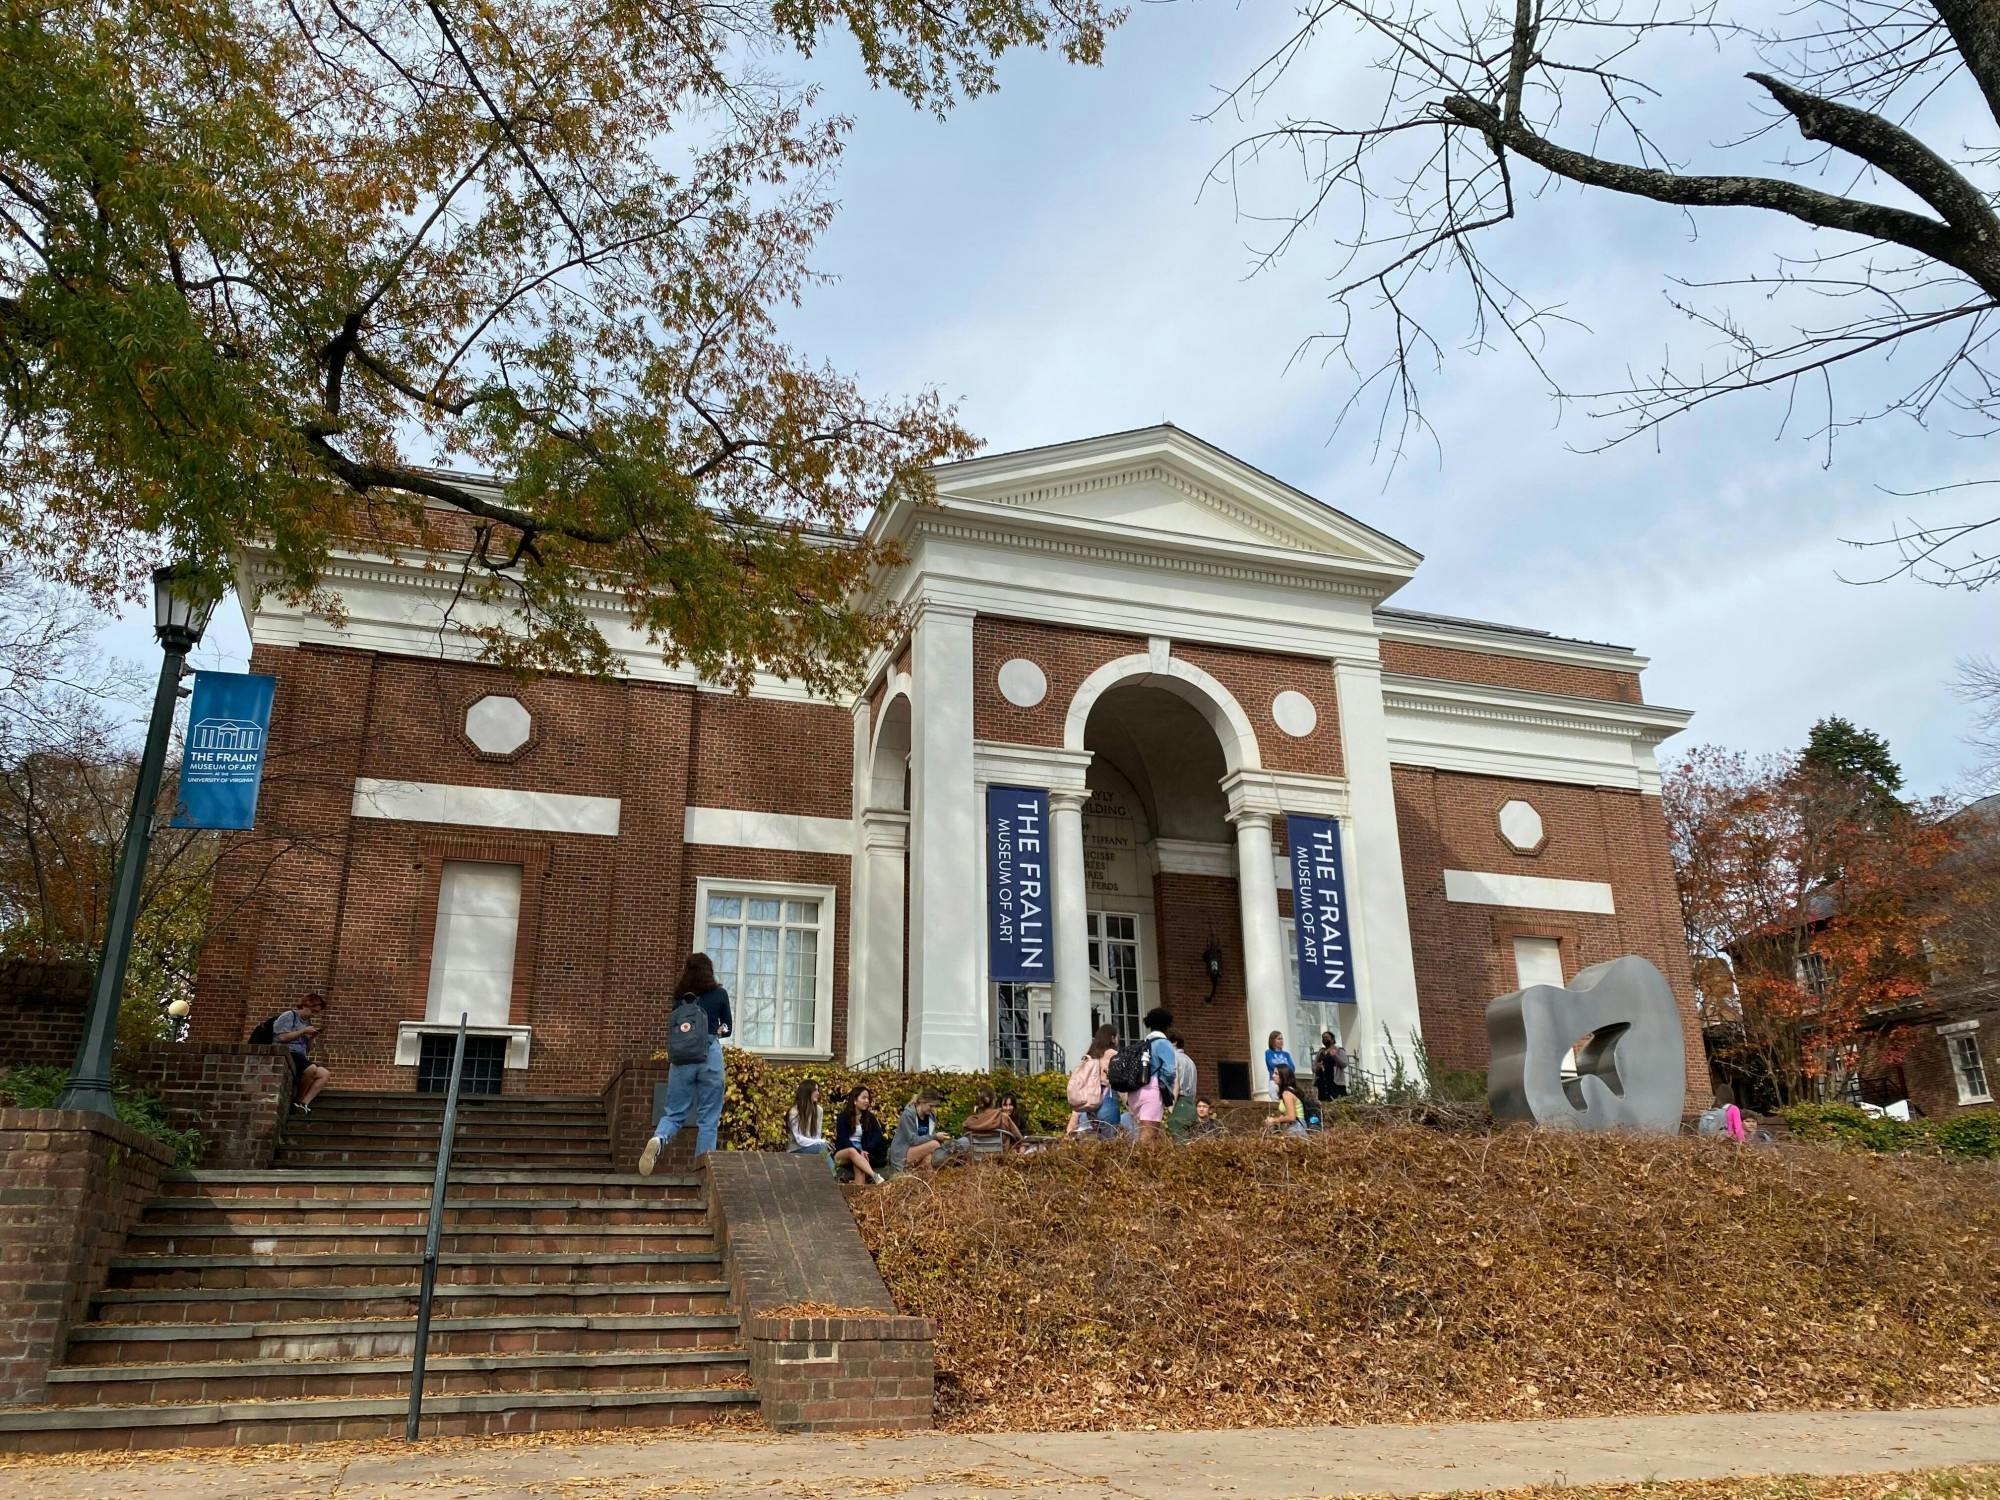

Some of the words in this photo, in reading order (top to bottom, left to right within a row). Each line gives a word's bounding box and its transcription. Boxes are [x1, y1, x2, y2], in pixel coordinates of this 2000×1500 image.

[191, 752, 214, 761] THE
[216, 753, 258, 762] FRALIN
[1017, 800, 1040, 853] THE
[1083, 803, 1126, 816] ILDING
[998, 818, 1012, 884] MUSEUM
[1313, 830, 1336, 881] THE
[1296, 846, 1313, 910] MUSEUM
[999, 890, 1013, 911] OF
[1019, 863, 1044, 968] FRALIN
[999, 913, 1014, 944] ART
[1302, 912, 1315, 935] OF
[1318, 889, 1346, 989] FRALIN
[1303, 936, 1318, 966] ART
